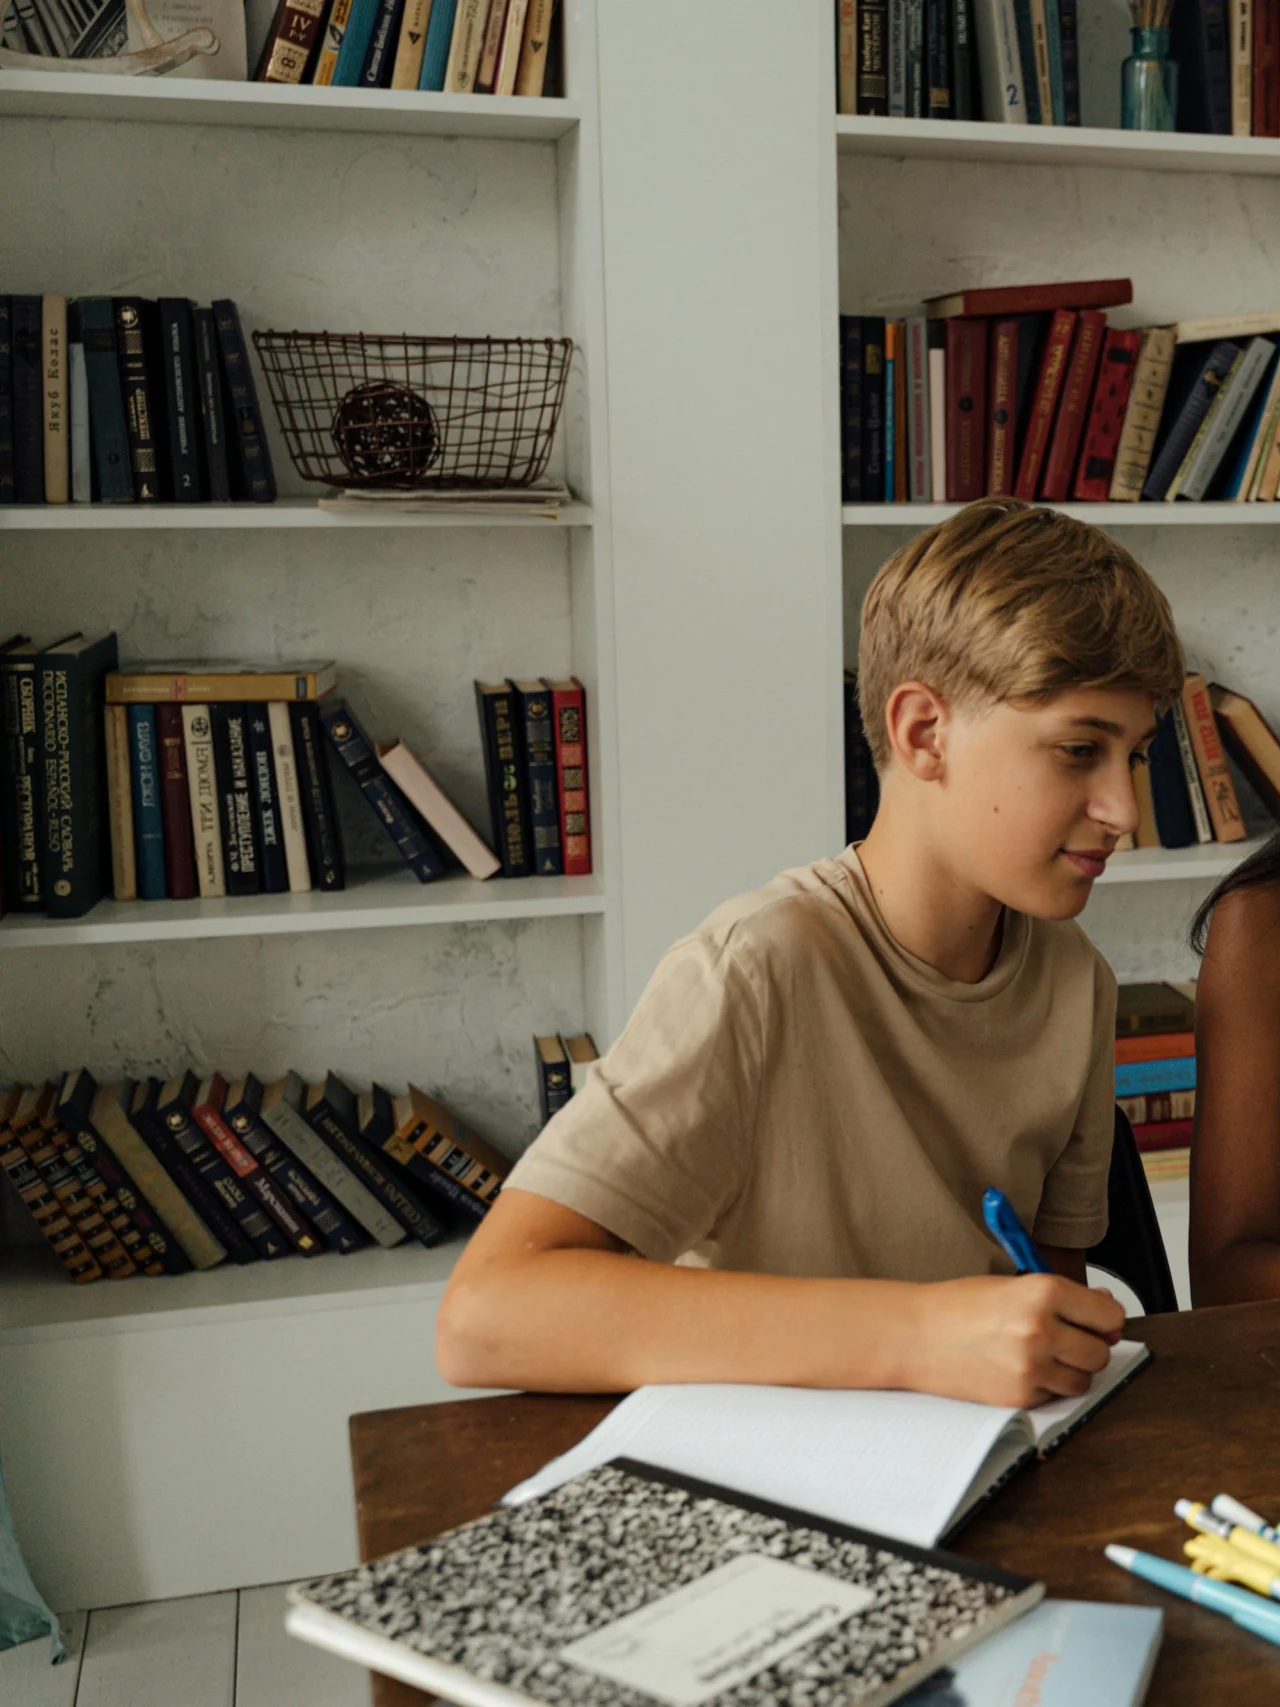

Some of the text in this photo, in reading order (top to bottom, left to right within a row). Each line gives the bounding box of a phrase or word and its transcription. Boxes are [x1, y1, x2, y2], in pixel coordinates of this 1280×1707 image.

[291, 15, 312, 32] IV
[1006, 83, 1020, 107] 2
[47, 328, 62, 433] Якуб Колас
[136, 388, 150, 440] ШЕКСПИР
[182, 474, 192, 488] 2
[42, 670, 62, 853] DICCIONARIO ESPAÑOL-RUSO
[55, 670, 74, 873] ИСПАНСКО-РУССКИЙ СЛОВАРЬ
[494, 700, 525, 866] ЖЮЛЬ ВЕРН
[200, 802, 215, 834] ТРИ
[234, 792, 255, 873] ПРЕСТУПЛЕНИЕ
[256, 751, 277, 846] ДЖЕК ЛОНДОН
[253, 1178, 300, 1233] Марсианин
